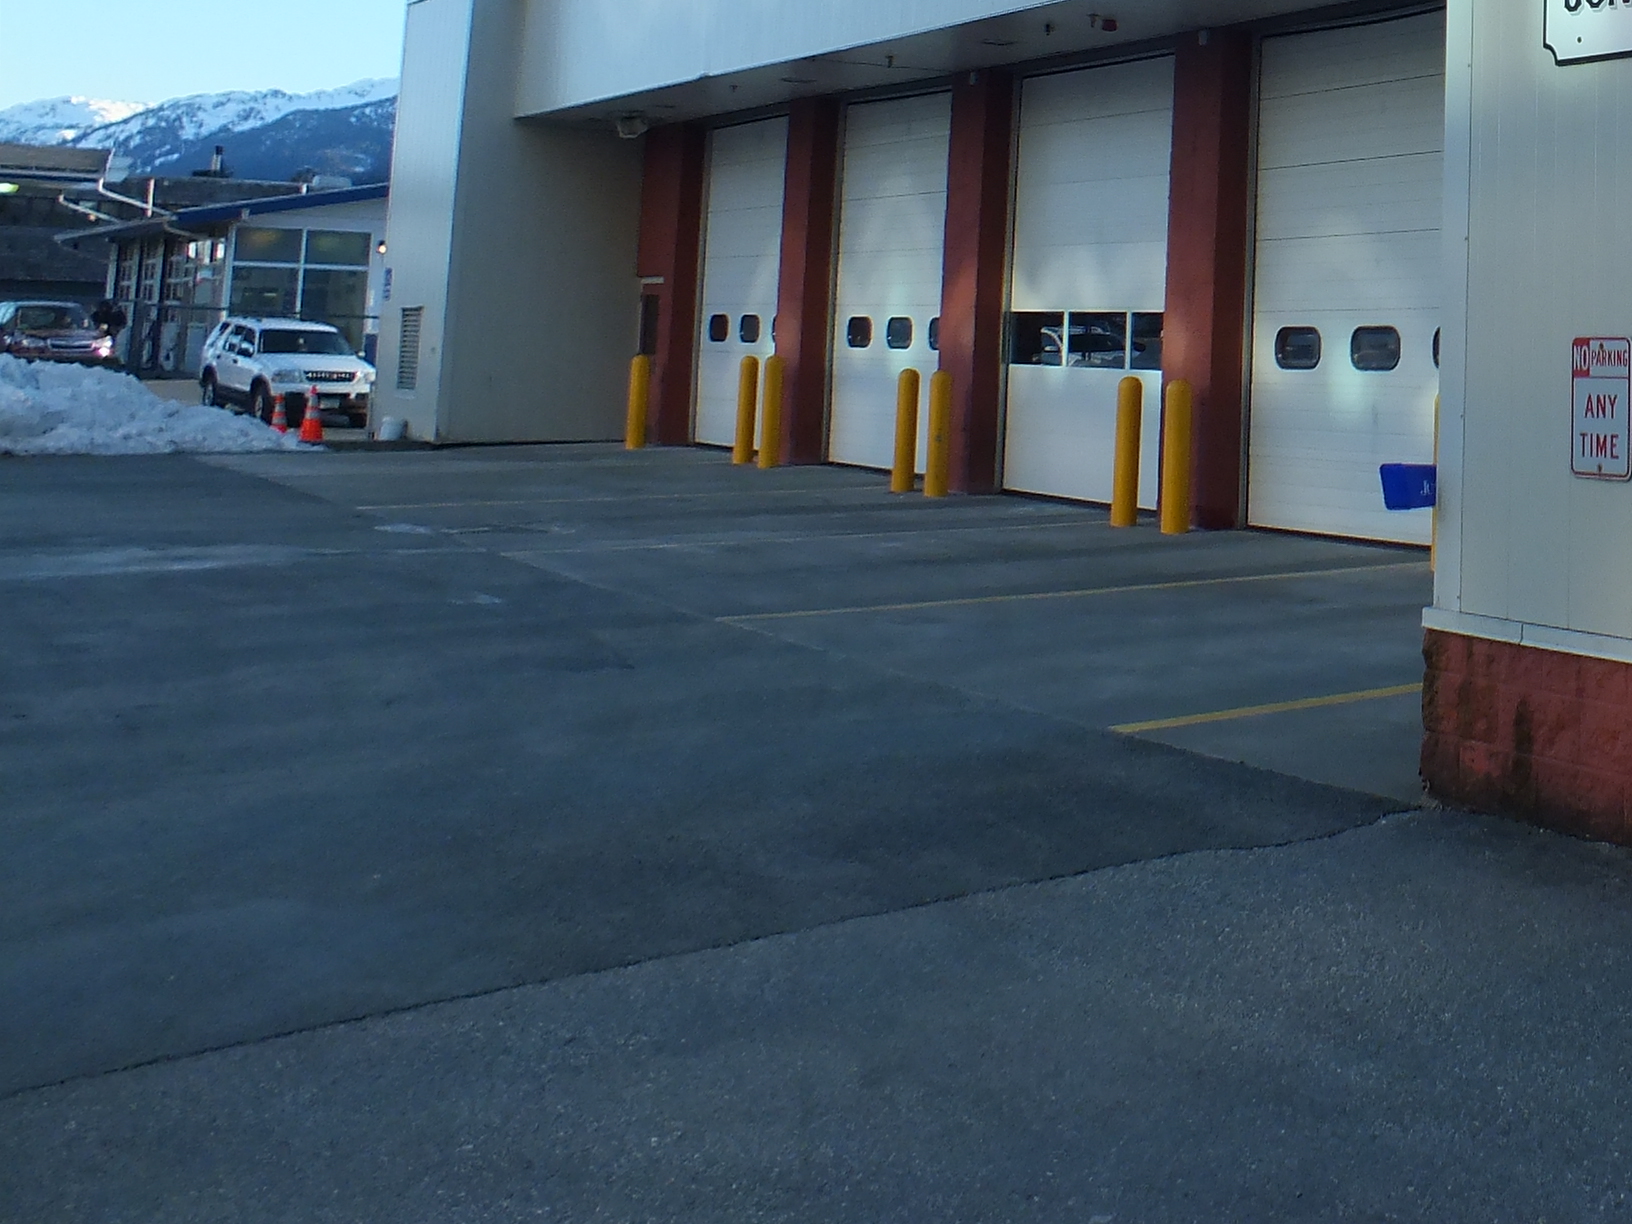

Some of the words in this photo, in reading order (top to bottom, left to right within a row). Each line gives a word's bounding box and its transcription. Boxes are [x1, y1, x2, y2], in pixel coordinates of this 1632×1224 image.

[1573, 345, 1589, 371] NO
[1591, 349, 1628, 367] PARKING
[1584, 392, 1618, 419] ANY
[1579, 432, 1620, 460] TIME
